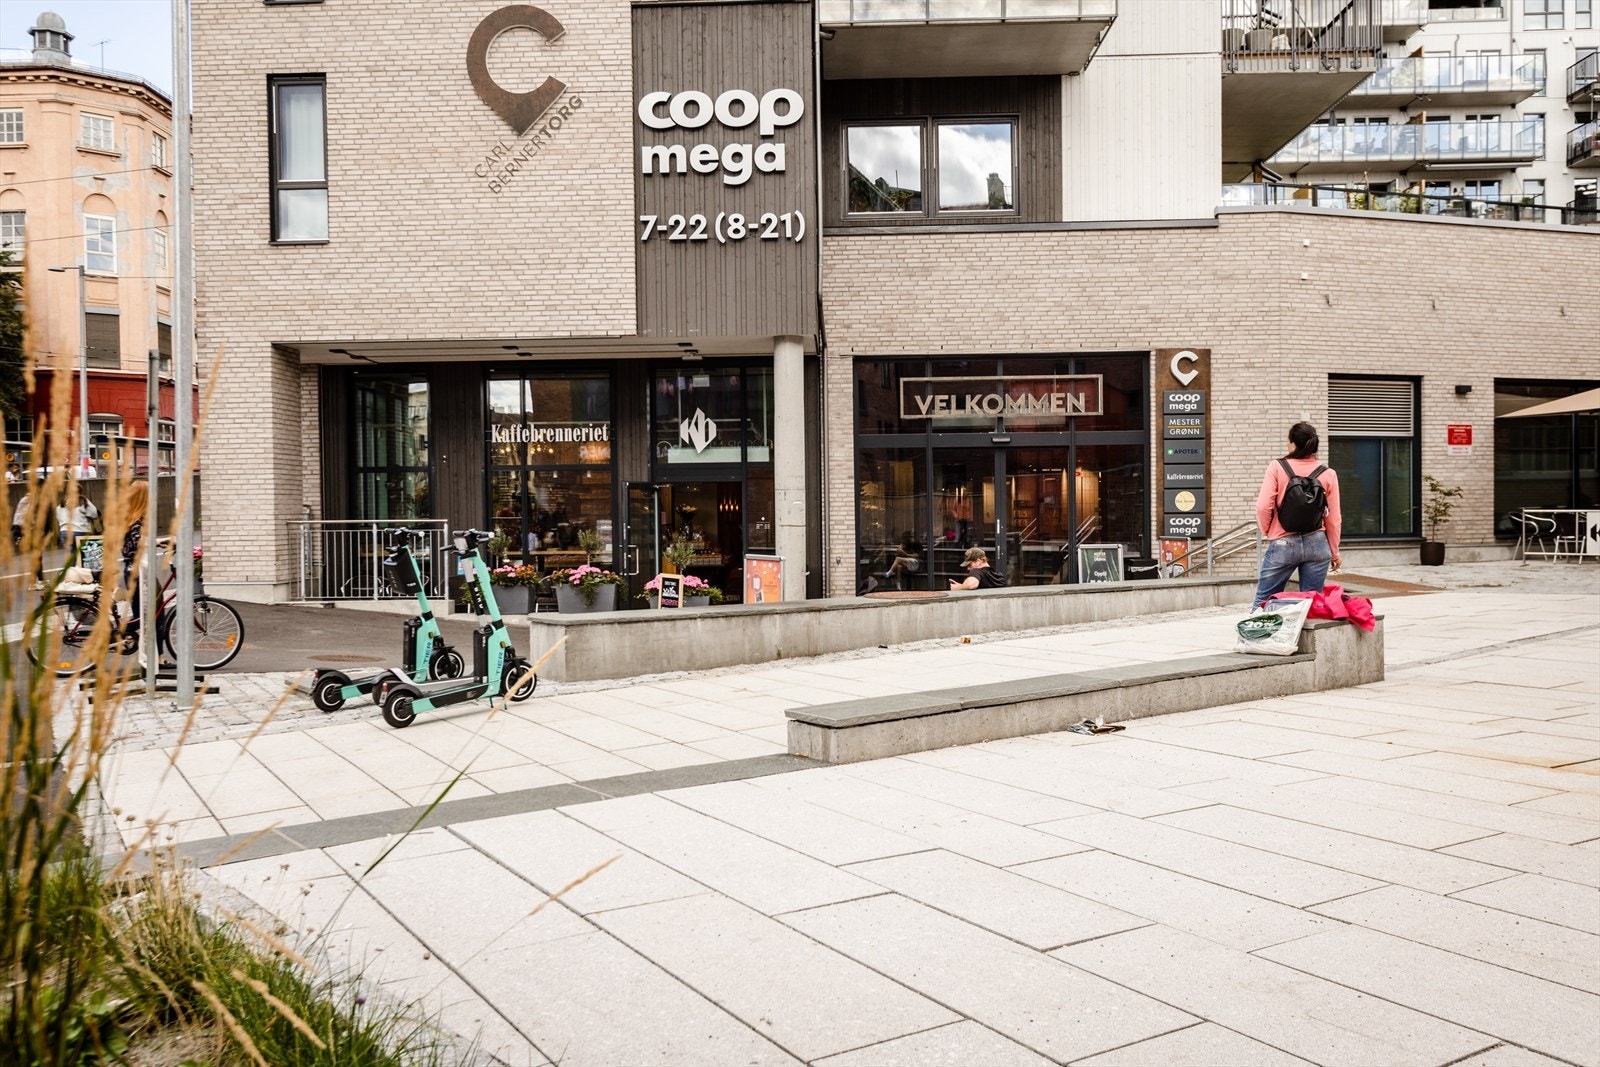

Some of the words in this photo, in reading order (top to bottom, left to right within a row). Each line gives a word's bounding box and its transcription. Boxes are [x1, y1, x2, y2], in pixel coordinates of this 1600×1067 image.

[638, 88, 805, 136] coop
[474, 141, 514, 178] CARL
[641, 142, 786, 186] mega
[640, 214, 708, 241] 7-22
[714, 210, 805, 244] (8-21)
[914, 392, 1086, 416] VELKOMMEN
[1168, 393, 1201, 403] coop
[1169, 403, 1197, 412] mega
[1169, 418, 1201, 426] MESTER
[491, 423, 609, 443] Kaffebrenneriet
[1169, 517, 1201, 526] coop
[1169, 526, 1198, 536] mega
[423, 641, 432, 664] TIER
